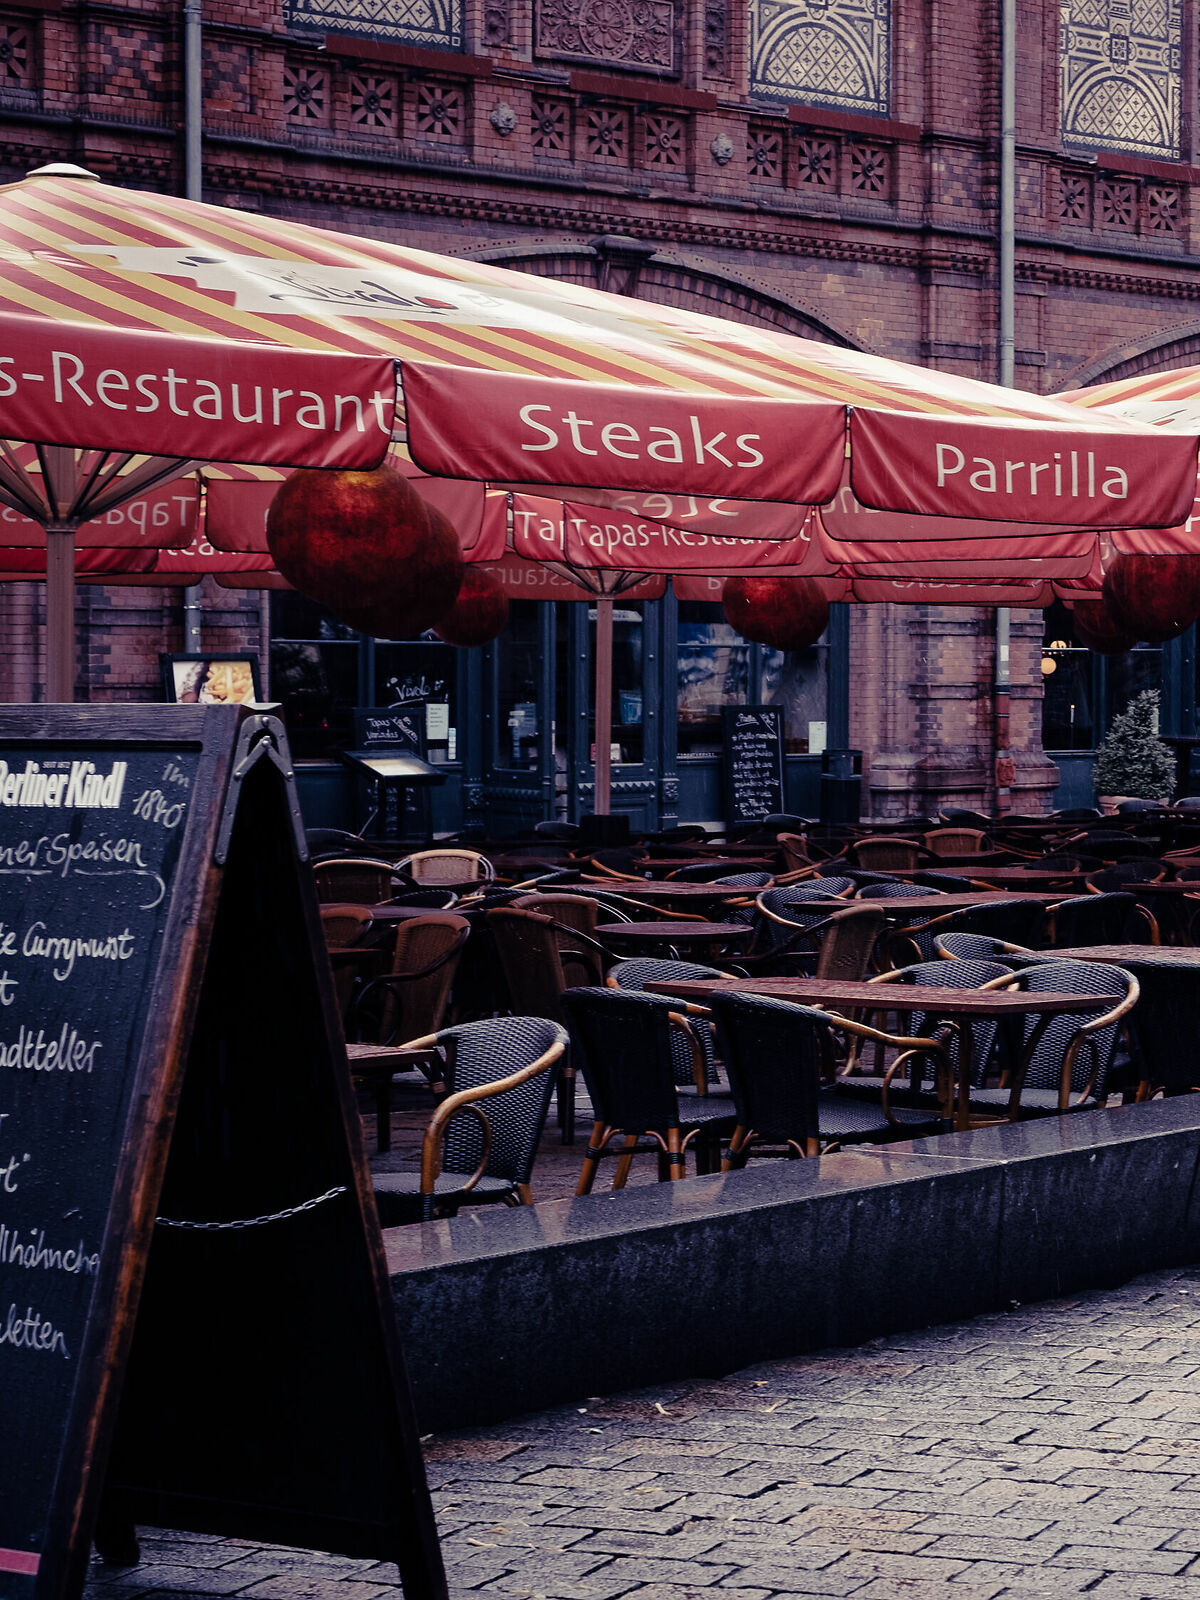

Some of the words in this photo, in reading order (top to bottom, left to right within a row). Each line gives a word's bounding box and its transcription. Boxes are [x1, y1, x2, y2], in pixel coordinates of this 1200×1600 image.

[519, 403, 764, 469] Steaks
[935, 443, 1129, 499] Parrilla
[64, 761, 128, 808] Kindl
[46, 832, 149, 878] Speisen
[22, 921, 136, 982] Currywurst
[0, 1303, 70, 1359] letten
